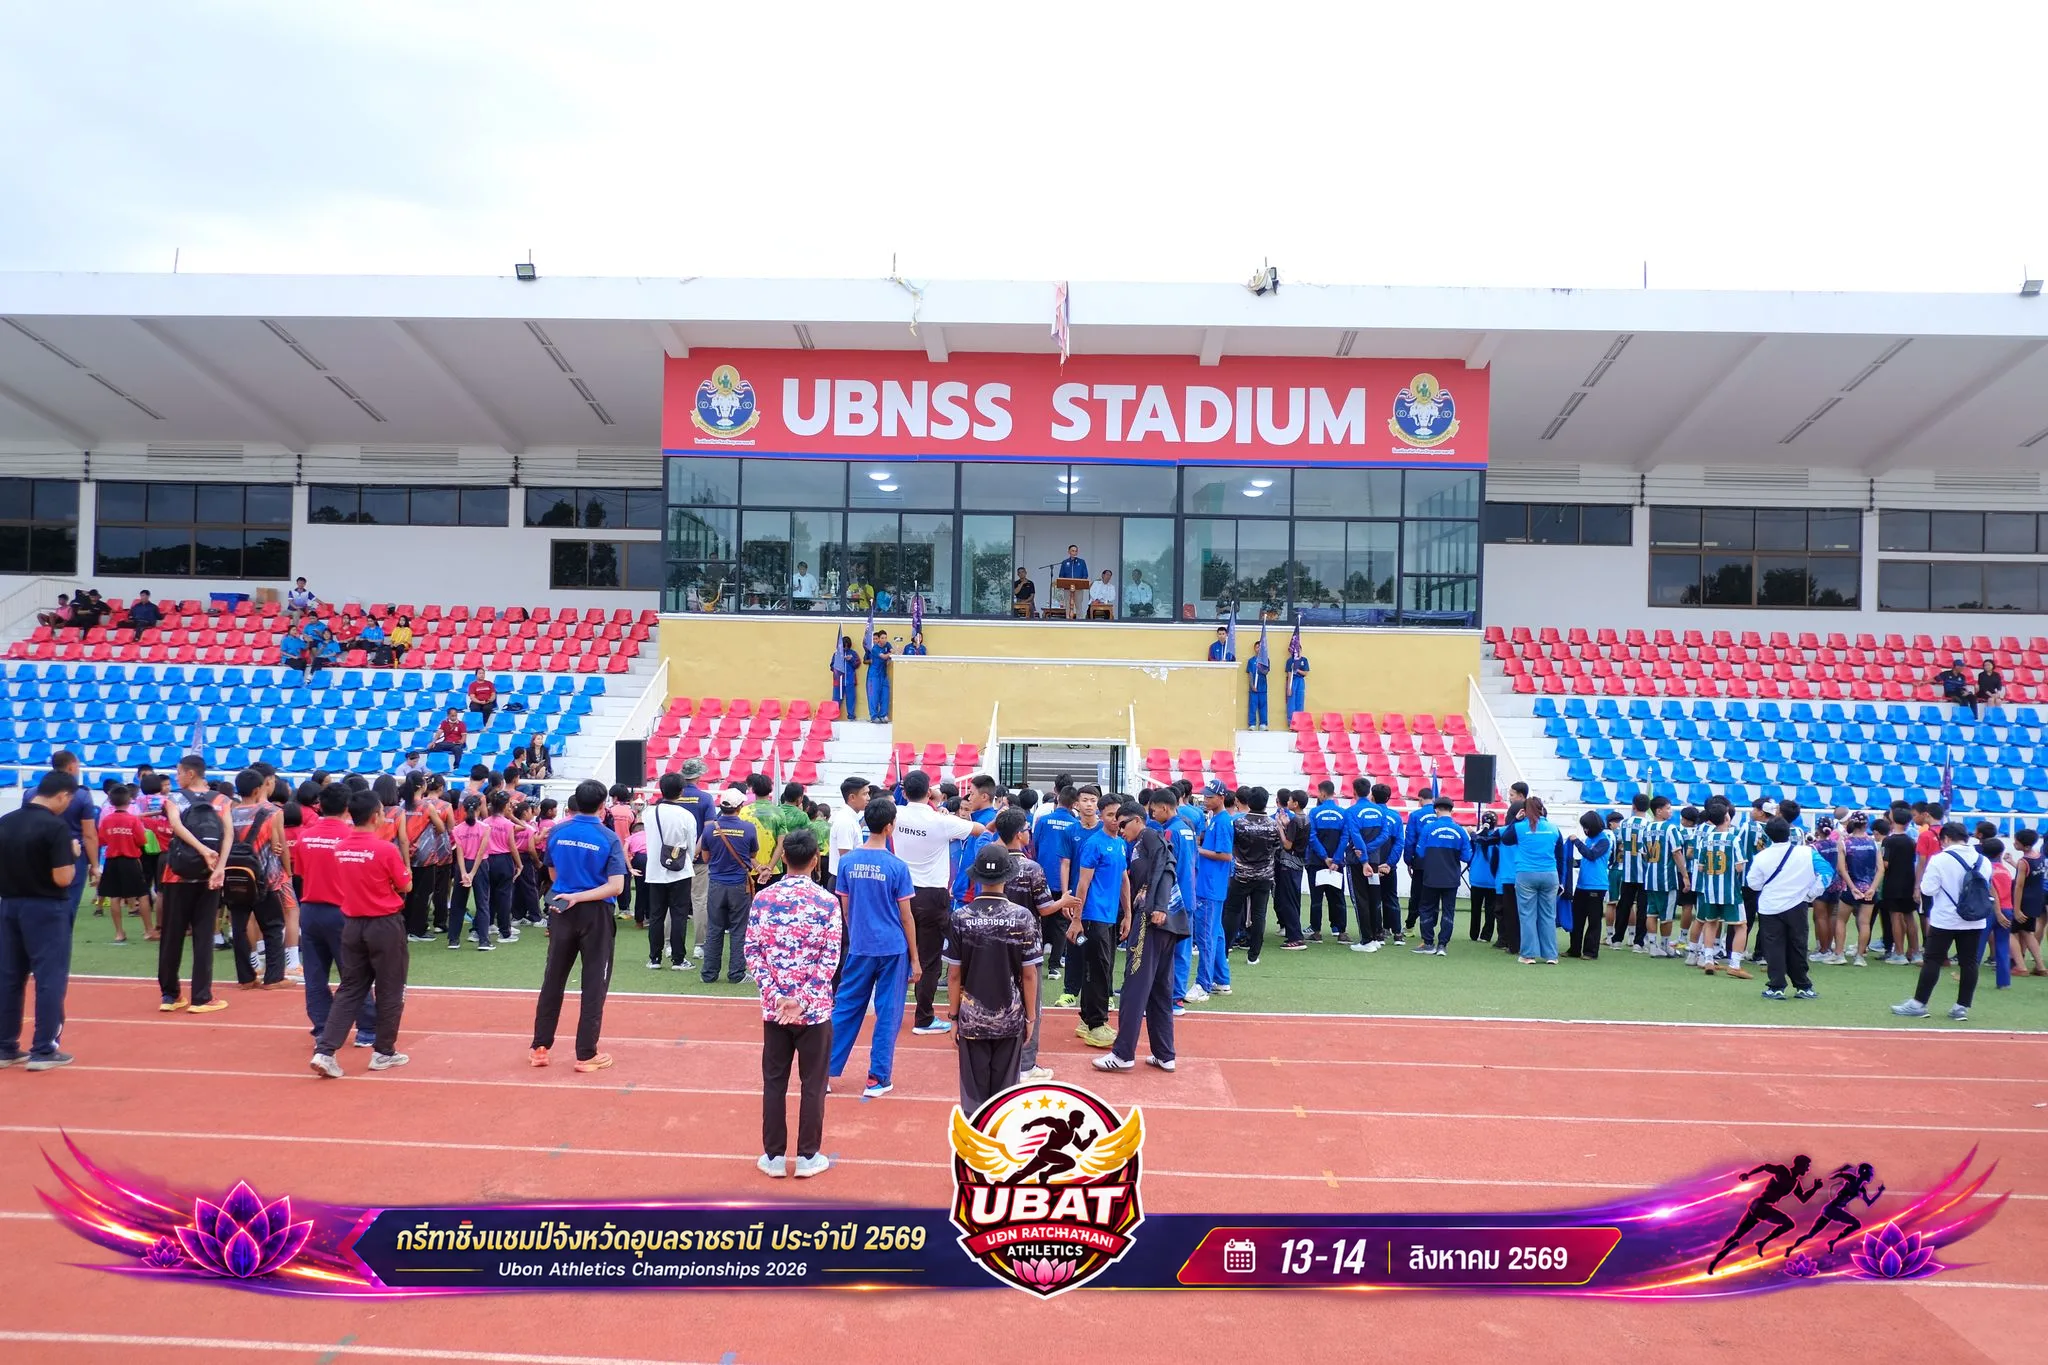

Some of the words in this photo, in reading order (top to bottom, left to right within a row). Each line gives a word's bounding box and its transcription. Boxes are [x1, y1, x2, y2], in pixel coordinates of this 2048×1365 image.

[782, 378, 1012, 440] UBNSS
[1051, 383, 1366, 446] STADIUM
[898, 826, 927, 837] UBNSS
[853, 863, 881, 873] UBNSS
[1706, 850, 1727, 875] 13
[848, 871, 887, 882] THAILAND
[965, 917, 1016, 928] อุบลราชธานี
